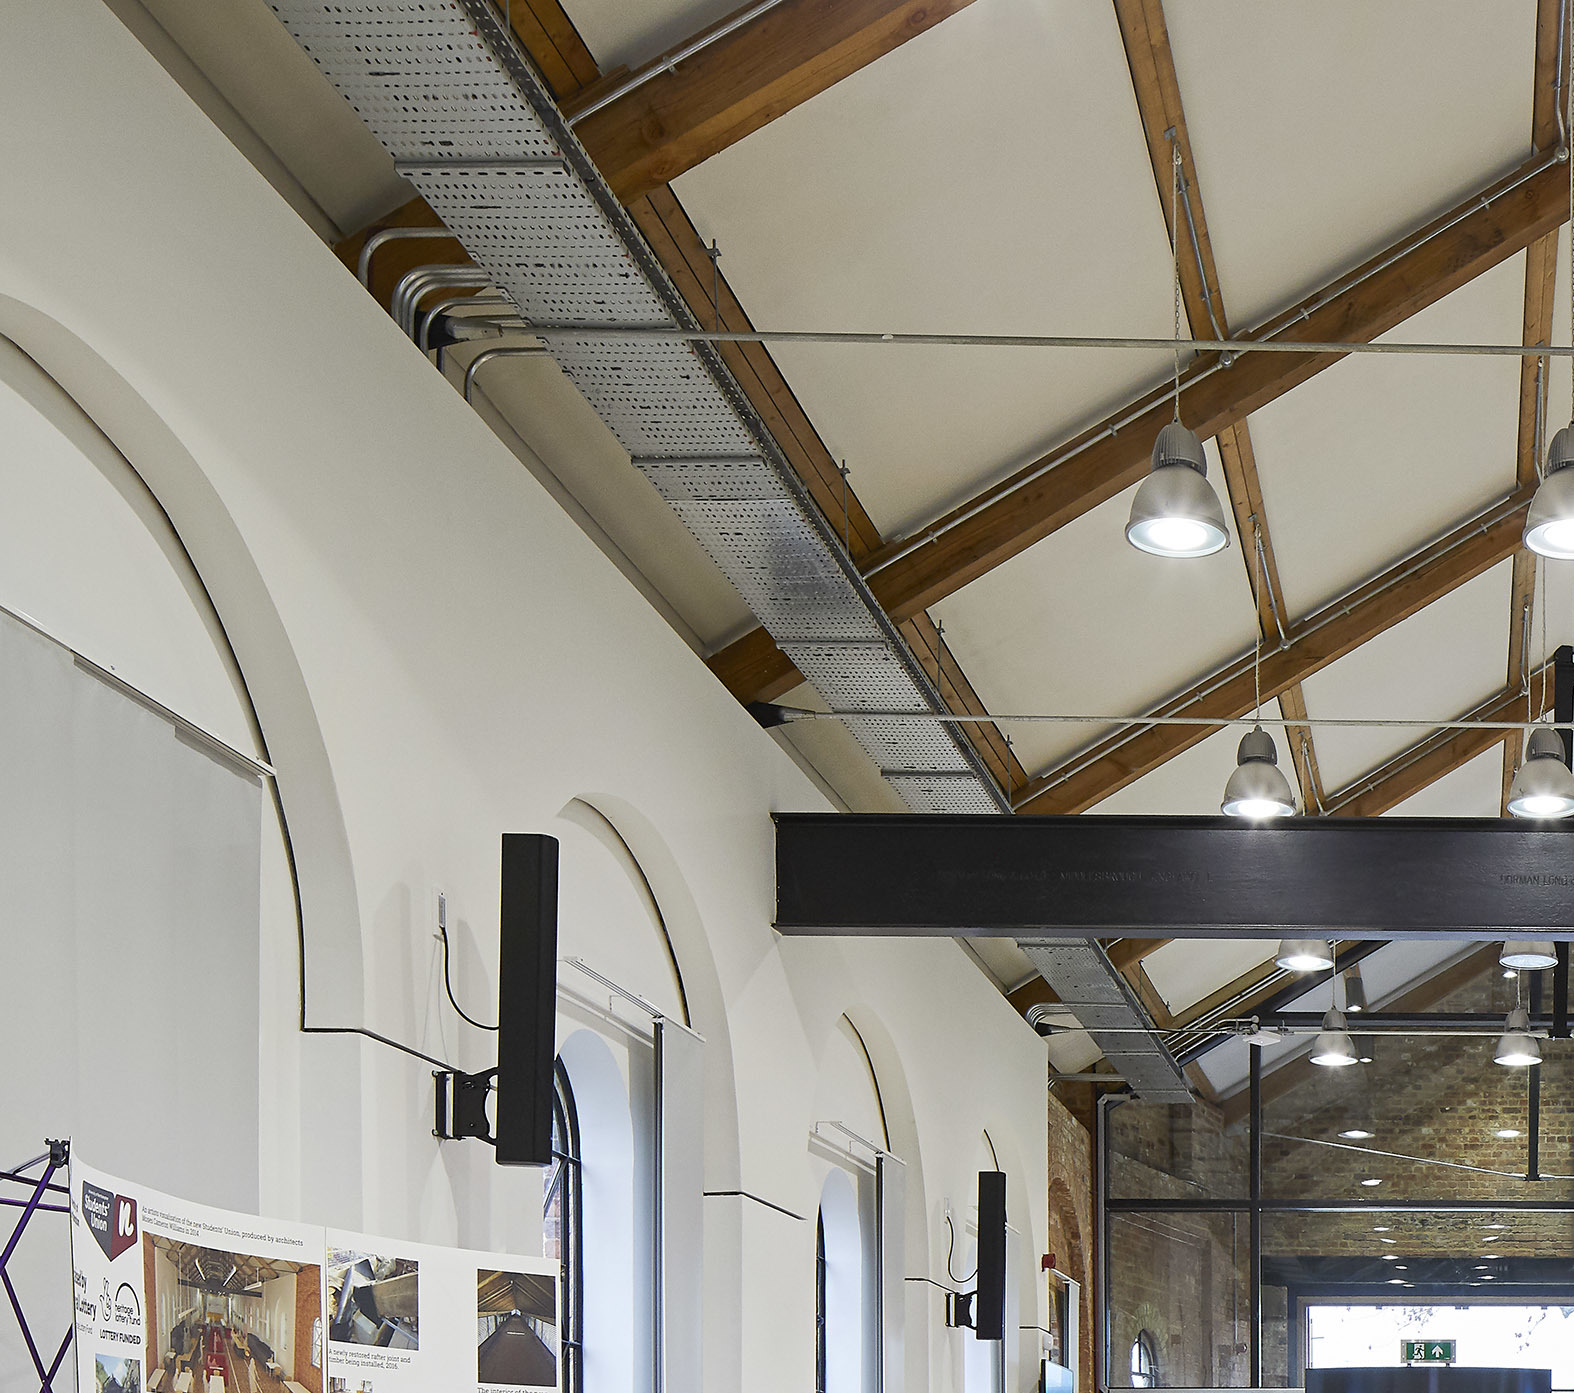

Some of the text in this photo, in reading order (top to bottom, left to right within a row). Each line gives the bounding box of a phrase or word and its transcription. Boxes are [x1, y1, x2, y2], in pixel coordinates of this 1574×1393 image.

[84, 1194, 110, 1216] Students'
[90, 1212, 108, 1232] Union
[242, 1232, 266, 1241] produced
[100, 1329, 140, 1344] LOTTERY FUNDED
